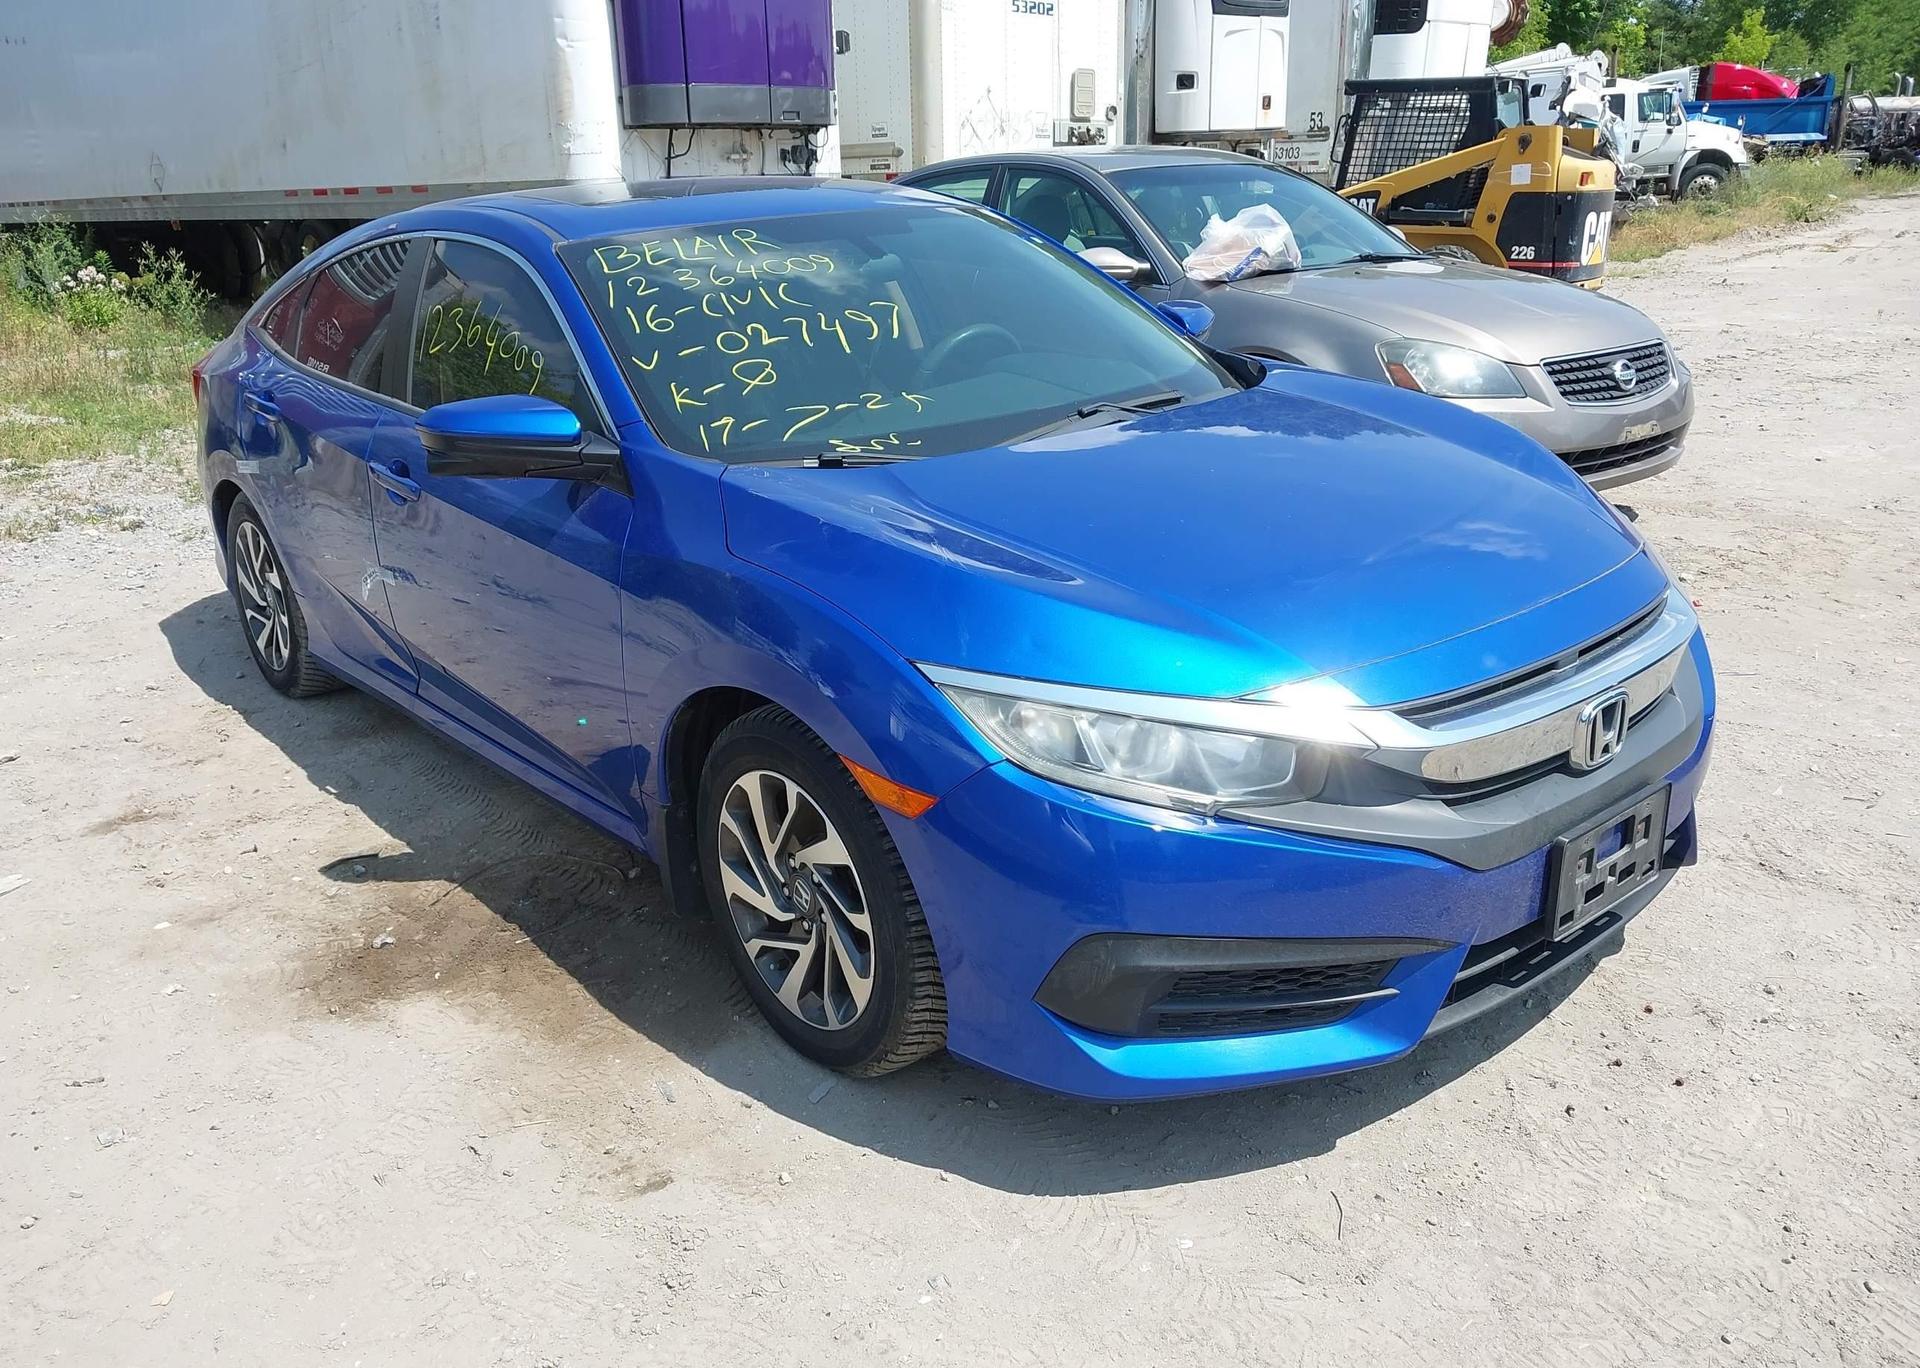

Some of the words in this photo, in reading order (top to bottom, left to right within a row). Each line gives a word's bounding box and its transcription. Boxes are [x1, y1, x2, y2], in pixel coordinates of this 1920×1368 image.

[1011, 0, 1054, 17] 53202
[594, 228, 783, 274] BELAIR
[1510, 245, 1536, 260] 226
[1580, 211, 1612, 266] CAT
[419, 300, 545, 396] 12364009
